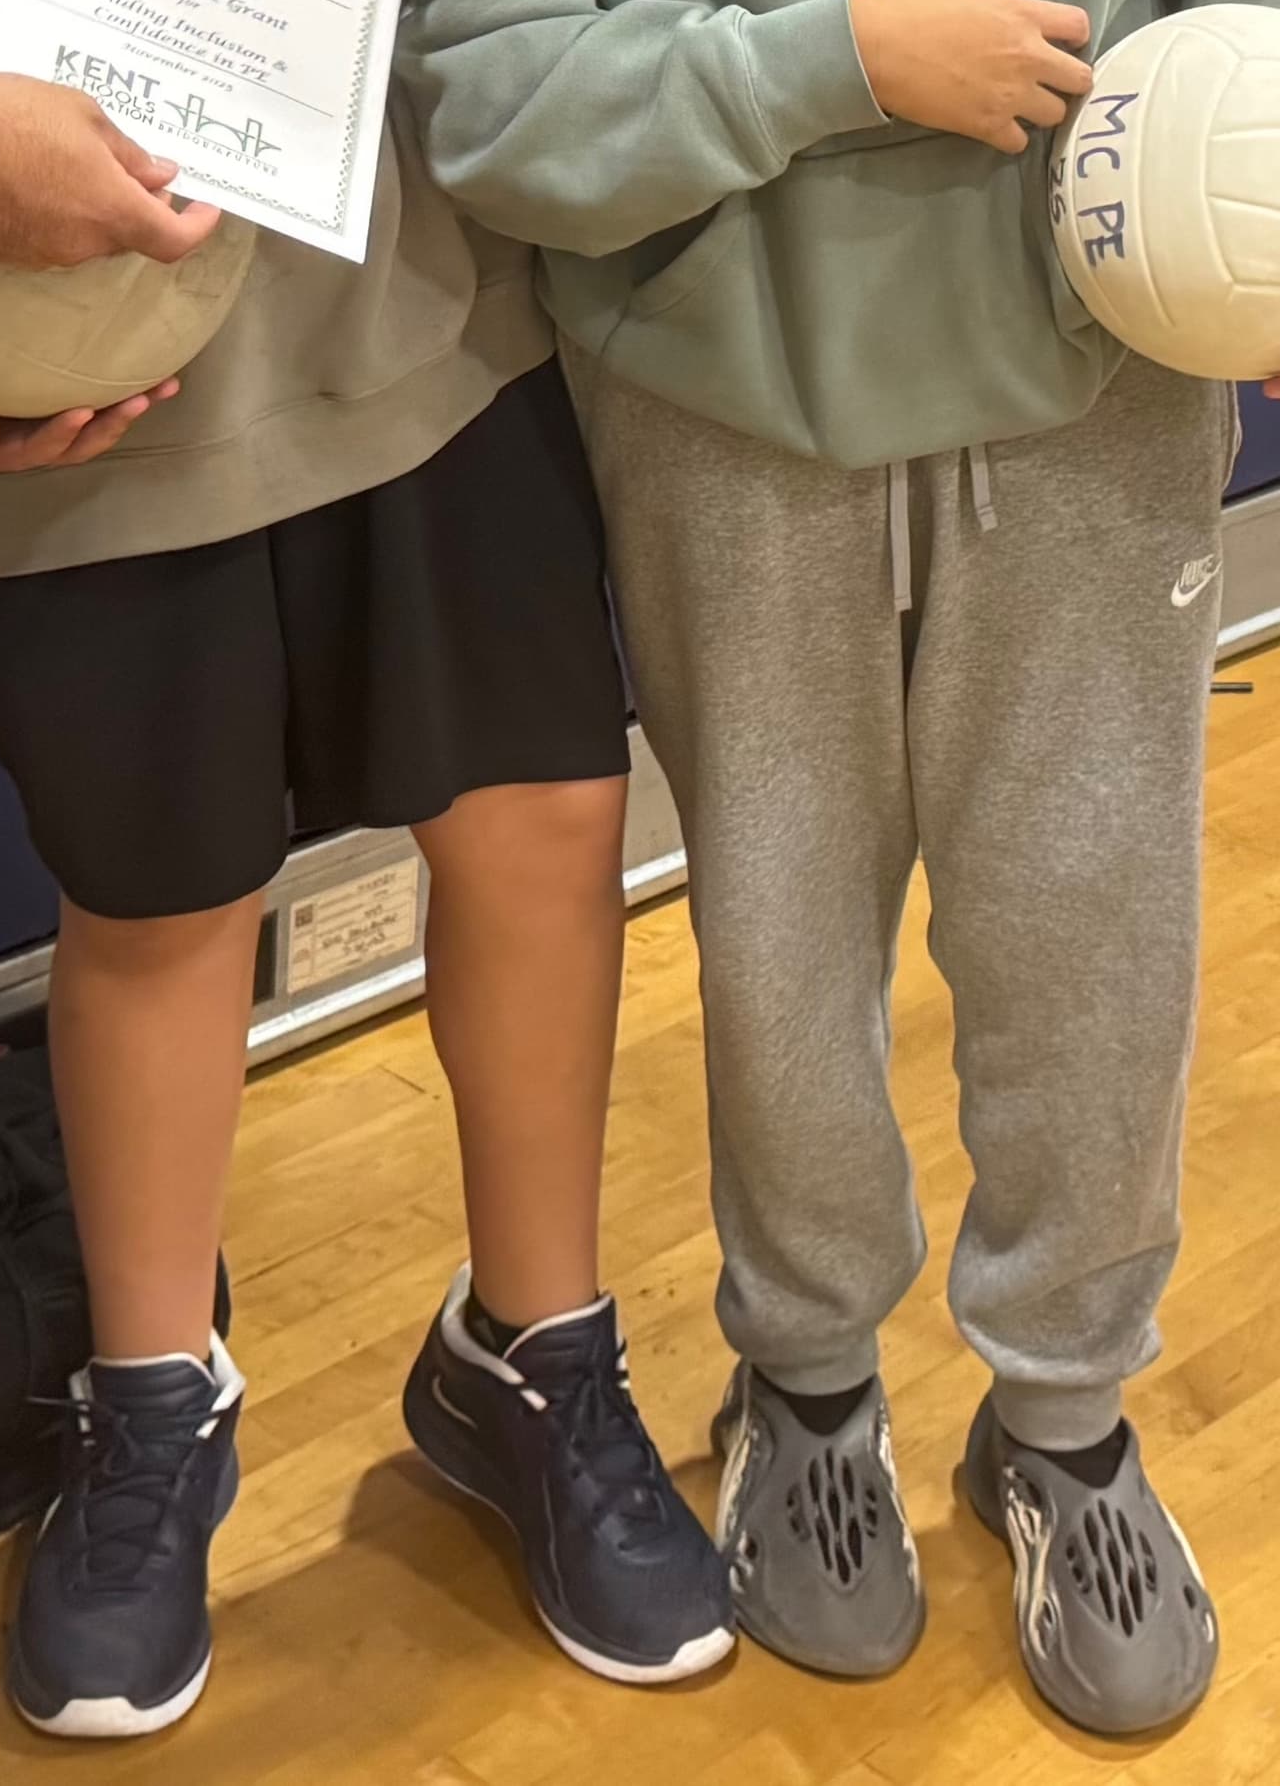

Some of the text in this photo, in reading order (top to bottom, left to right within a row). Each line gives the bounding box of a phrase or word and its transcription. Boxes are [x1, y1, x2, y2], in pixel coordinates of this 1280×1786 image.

[94, 6, 208, 58] Confidence
[213, 52, 235, 69] in
[173, 19, 268, 64] Inclusion
[271, 59, 289, 73] &
[55, 44, 161, 100] KENT
[1077, 92, 1140, 268] MC PE
